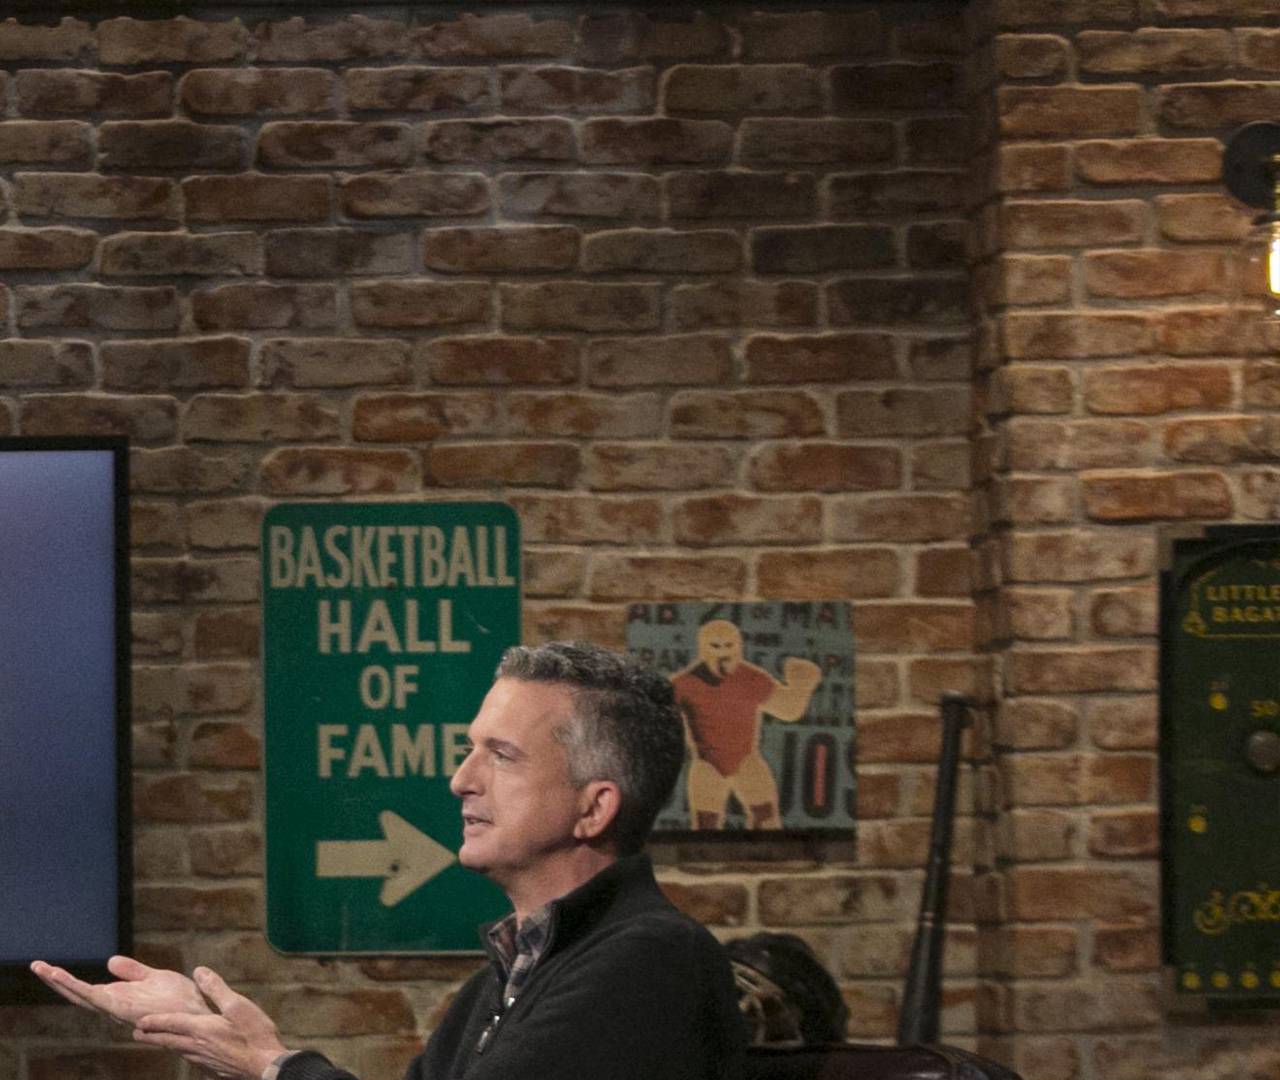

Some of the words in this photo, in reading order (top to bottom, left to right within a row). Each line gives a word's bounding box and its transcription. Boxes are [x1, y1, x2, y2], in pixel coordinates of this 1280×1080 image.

[270, 525, 515, 589] BASKETBALL
[318, 599, 472, 654] HALL
[359, 665, 419, 711] OF
[318, 723, 471, 778] FAME
